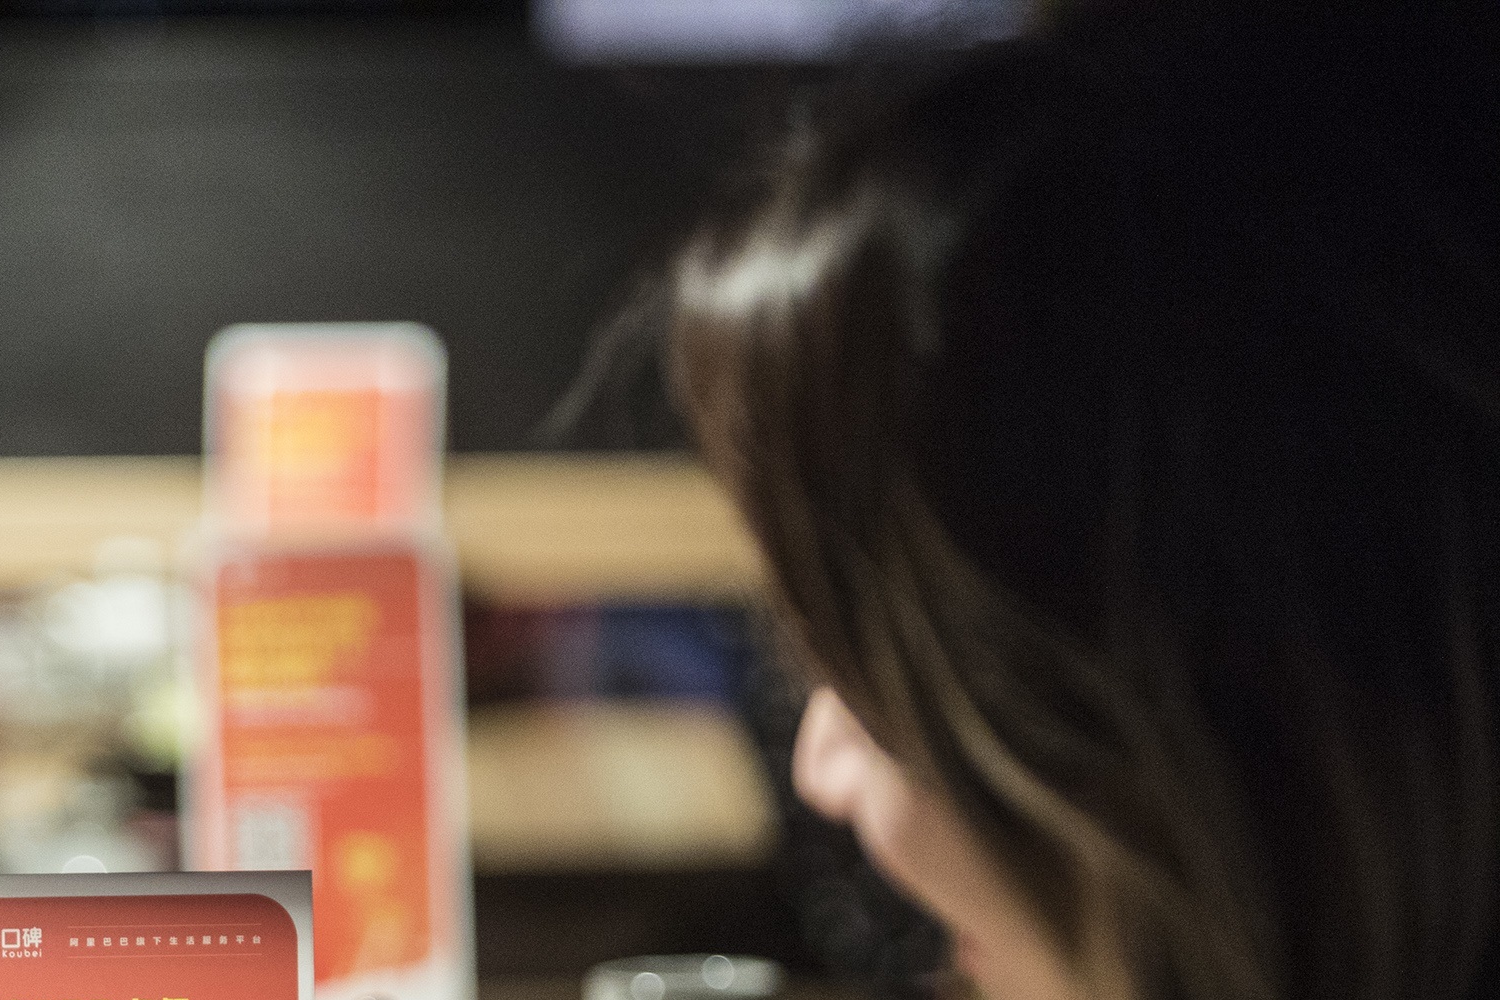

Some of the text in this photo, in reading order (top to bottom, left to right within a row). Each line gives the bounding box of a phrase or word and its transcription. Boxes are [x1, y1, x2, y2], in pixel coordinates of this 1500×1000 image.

[1, 927, 42, 948] 口碑
[69, 935, 261, 947] 阿里巴巴旗下生活服务平台
